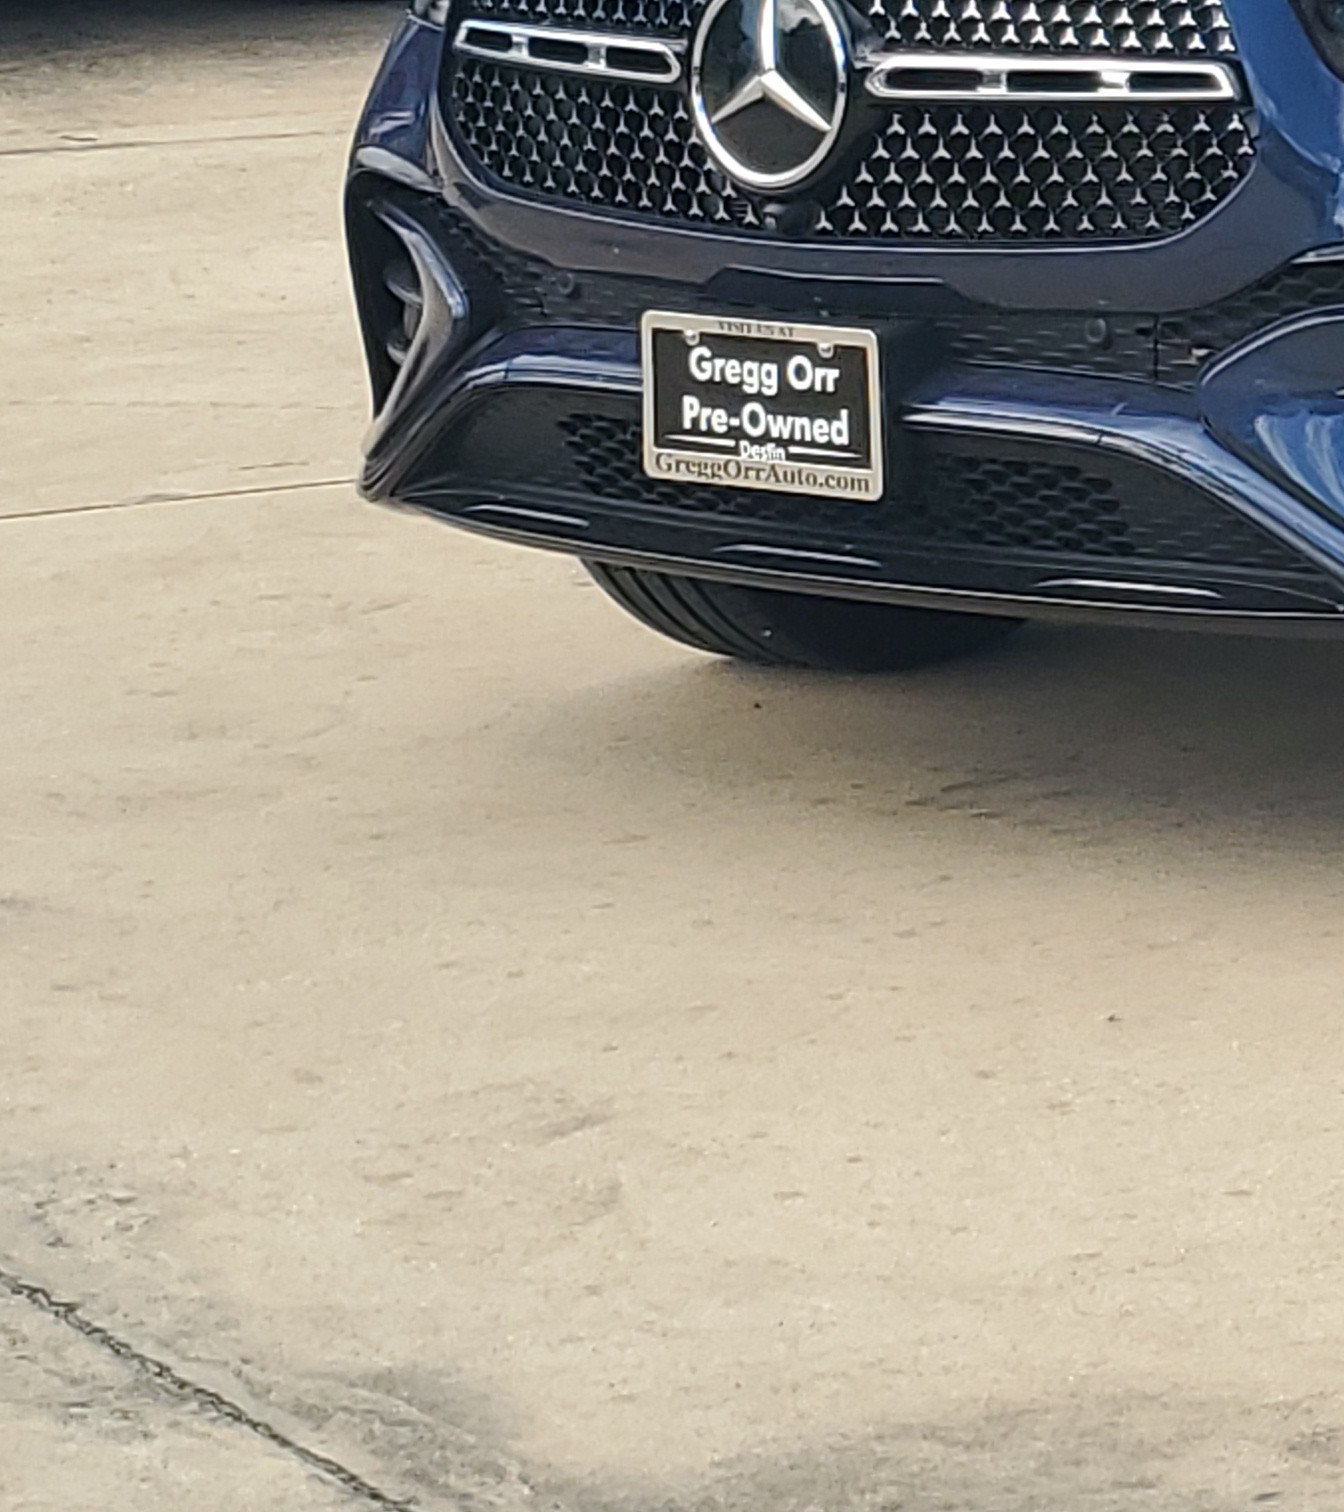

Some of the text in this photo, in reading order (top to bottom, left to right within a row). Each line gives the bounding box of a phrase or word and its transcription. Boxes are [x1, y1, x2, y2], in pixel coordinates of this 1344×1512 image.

[688, 345, 840, 396] Gregg Orr
[682, 395, 849, 445] Pre-Owned
[655, 452, 870, 493] GreggOrrAuto.com
